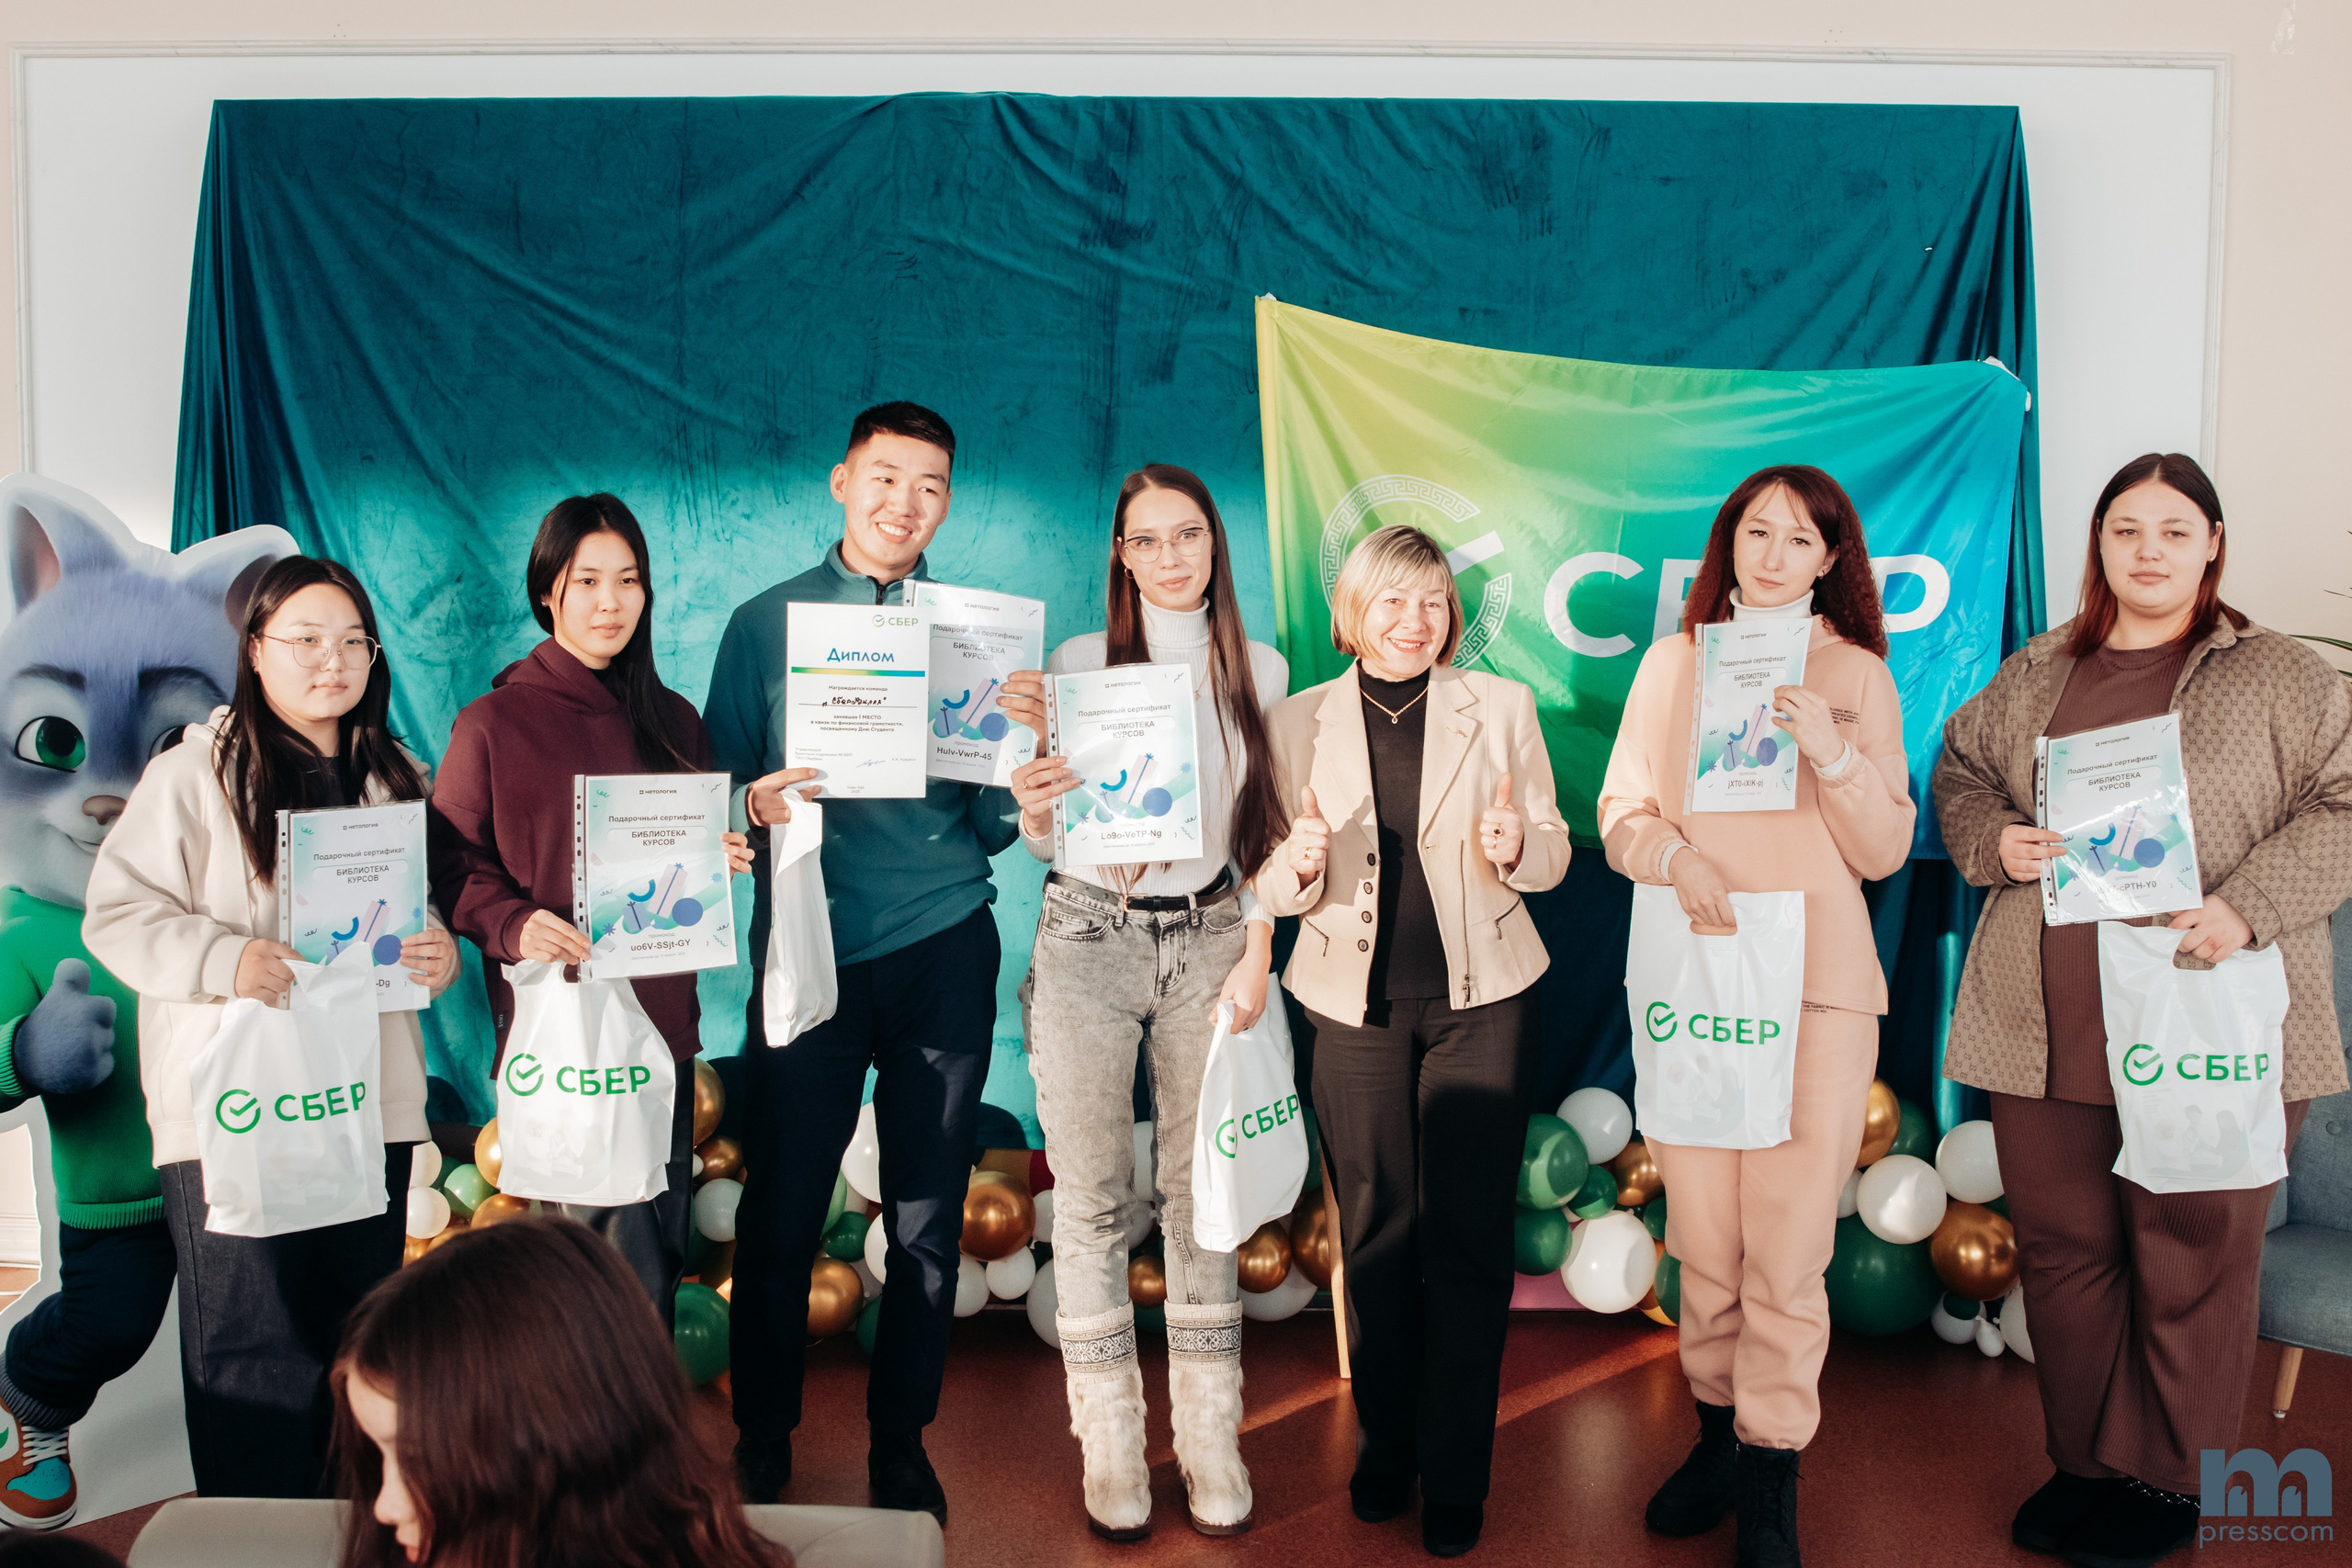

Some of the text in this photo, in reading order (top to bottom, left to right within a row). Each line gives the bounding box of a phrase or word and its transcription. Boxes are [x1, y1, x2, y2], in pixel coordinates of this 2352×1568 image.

[888, 616, 919, 626] СБЕР
[933, 624, 1023, 641] Подарочный сертификат
[953, 642, 1006, 654] БИБЛИОТЕКА
[827, 648, 895, 662] Диплом
[963, 651, 994, 660] КУРСОВ
[1719, 656, 1786, 667] Подарочный сертификат
[1734, 671, 1770, 682] БИБЛИОТЕКА
[1078, 705, 1171, 717] Подарочный сертификат
[1101, 721, 1155, 731] БИБЛИОТЕКА
[1113, 730, 1145, 739] КУРСОВ
[2067, 754, 2158, 775] Подарочный сертификат
[2088, 772, 2142, 786] БИБЛИОТЕКА
[2098, 782, 2131, 792] КУРСОВ
[608, 814, 705, 823] Подарочный сертификат
[631, 830, 687, 839] БИБЛИОТЕКА
[313, 847, 405, 861] Подарочный сертификат
[336, 864, 390, 876] БИБЛИОТЕКА
[347, 874, 379, 884] КУРСОВ
[1689, 1014, 1781, 1045] СБЕР
[2177, 1053, 2269, 1081] СБЕР
[556, 1066, 650, 1096] СБЕР
[274, 1081, 366, 1122] СБЕР
[1241, 1093, 1299, 1139] СБЕР
